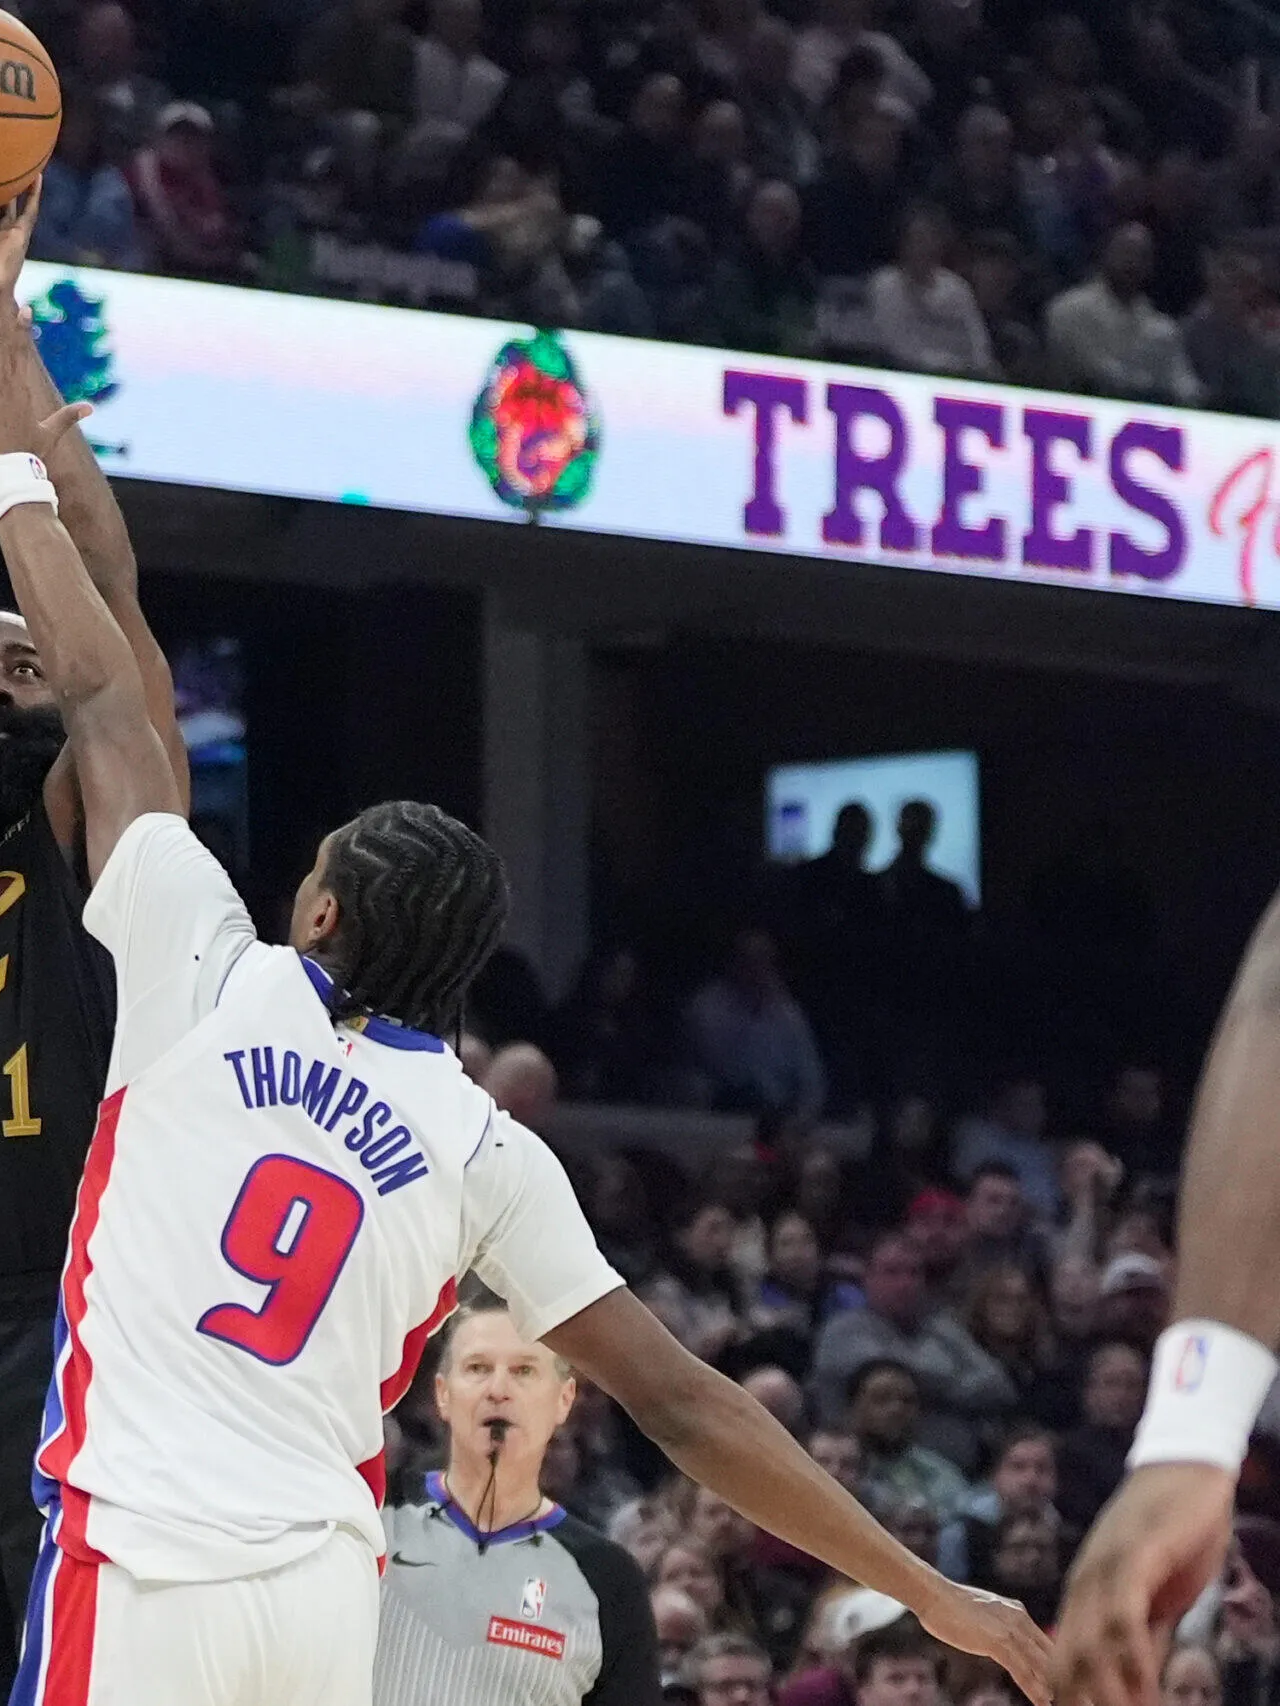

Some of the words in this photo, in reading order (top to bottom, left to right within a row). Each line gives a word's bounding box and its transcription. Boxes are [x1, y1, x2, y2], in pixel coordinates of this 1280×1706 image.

[723, 369, 1187, 582] TREES
[2, 1042, 42, 1138] 1
[223, 1046, 429, 1197] THOMPSON
[196, 1153, 365, 1367] 9
[489, 1620, 563, 1655] Emirates
